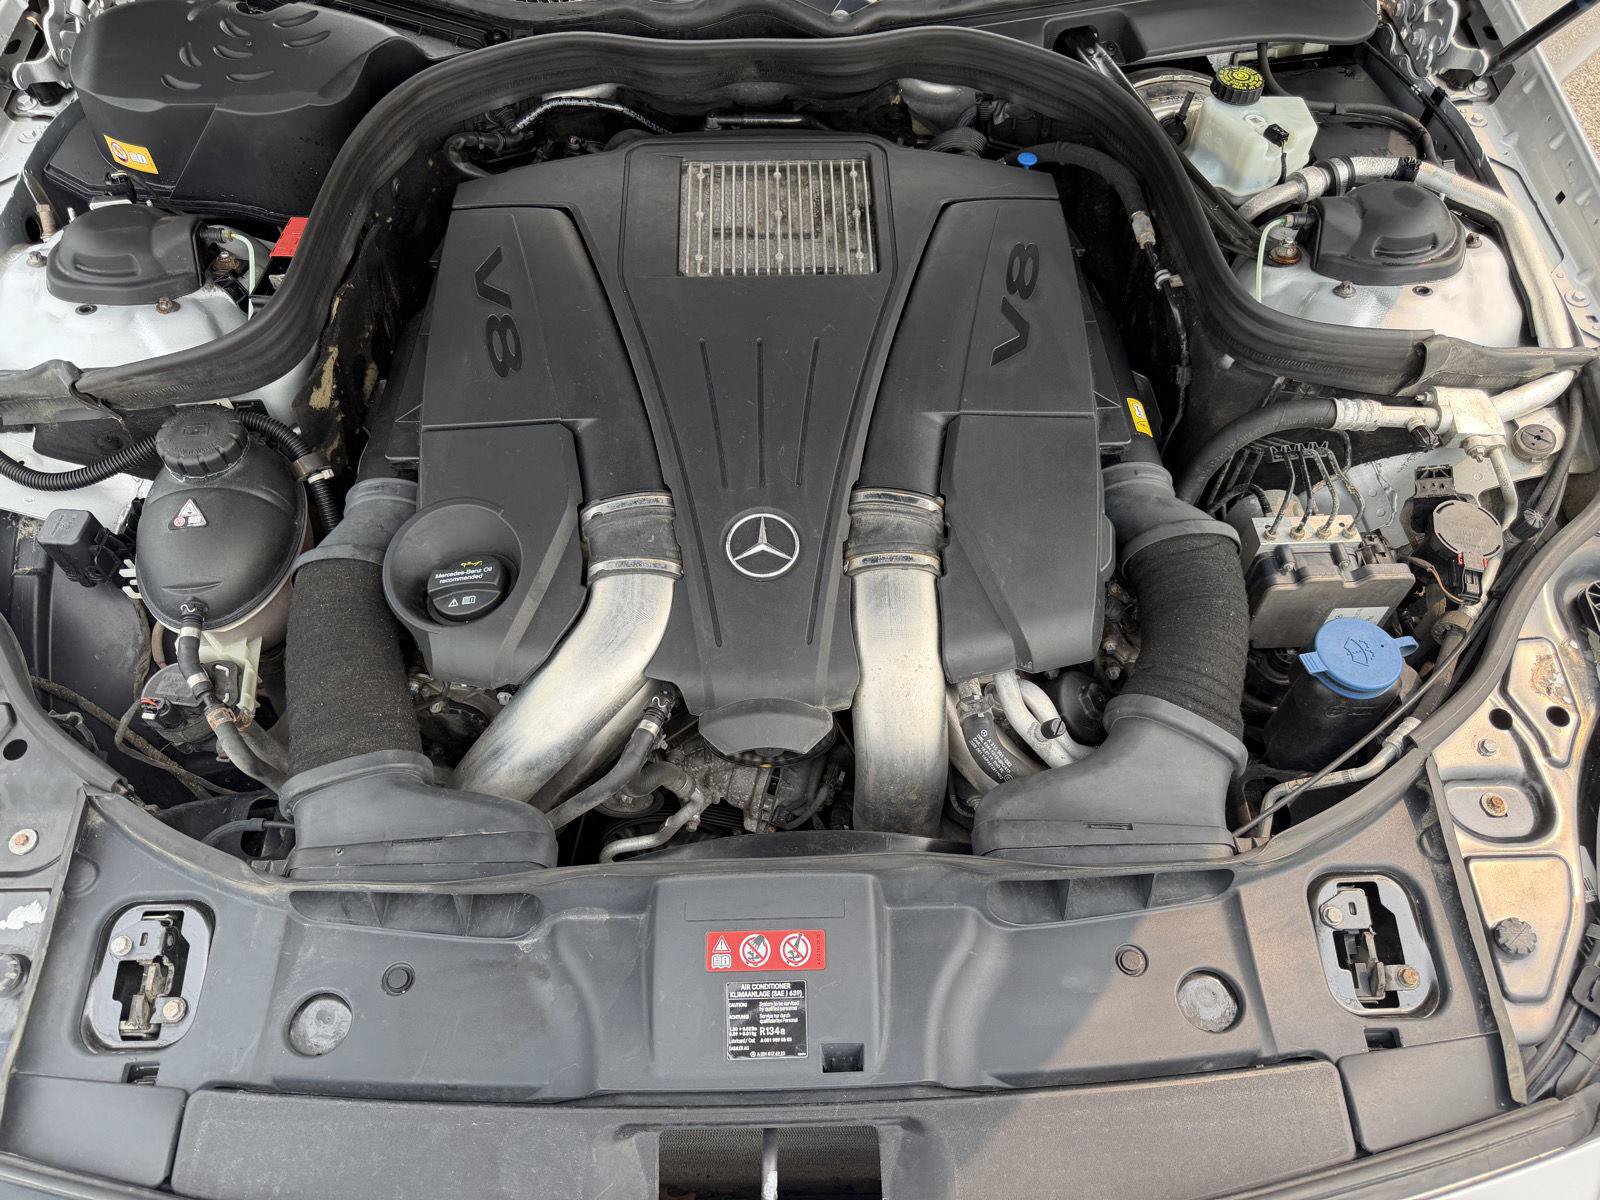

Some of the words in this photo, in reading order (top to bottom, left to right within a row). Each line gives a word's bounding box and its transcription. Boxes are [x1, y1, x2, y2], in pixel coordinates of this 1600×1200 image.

[990, 242, 1040, 367] V8
[474, 245, 522, 378] V8
[435, 568, 482, 578] Mercedes-Benz
[440, 573, 484, 584] recommended
[772, 990, 784, 998] (SAE
[789, 990, 803, 998] 639)
[760, 1026, 786, 1036] R134a
